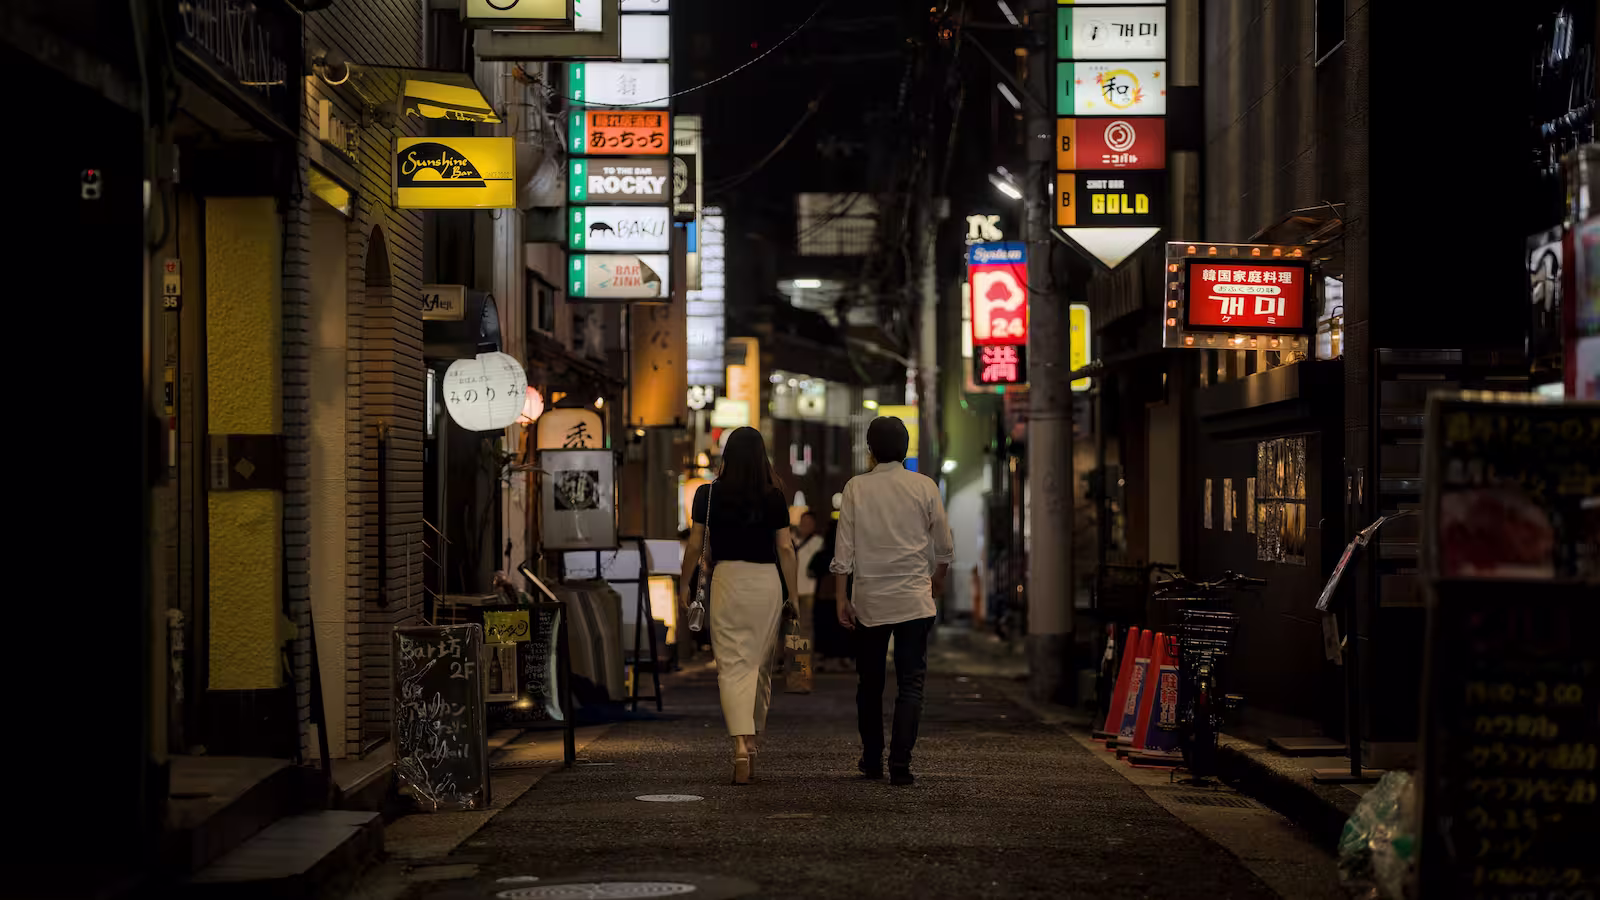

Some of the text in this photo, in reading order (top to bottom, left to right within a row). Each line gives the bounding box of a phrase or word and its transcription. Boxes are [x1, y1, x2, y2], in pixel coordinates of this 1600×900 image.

[1111, 23, 1158, 37] 개미
[1102, 77, 1129, 102] 和
[590, 131, 665, 148] あっちっち
[1062, 136, 1071, 152] B
[401, 151, 468, 175] Sunshine
[451, 166, 473, 178] Bar
[603, 167, 616, 175] TO
[616, 167, 634, 175] THE
[588, 176, 667, 195] ROCKY
[1062, 192, 1071, 207] B
[1092, 194, 1149, 214] GOLD
[618, 220, 666, 238] BAKU
[615, 265, 640, 276] BAR
[1201, 269, 1292, 284] 韓国家庭料理
[613, 276, 641, 287] ZINK
[1217, 286, 1275, 294] おふくろの味
[973, 271, 1025, 340] P
[1208, 295, 1286, 316] 개미
[992, 317, 1026, 337] 24
[982, 345, 1018, 382] 満
[450, 386, 496, 404] みのり
[450, 661, 475, 680] 2F
